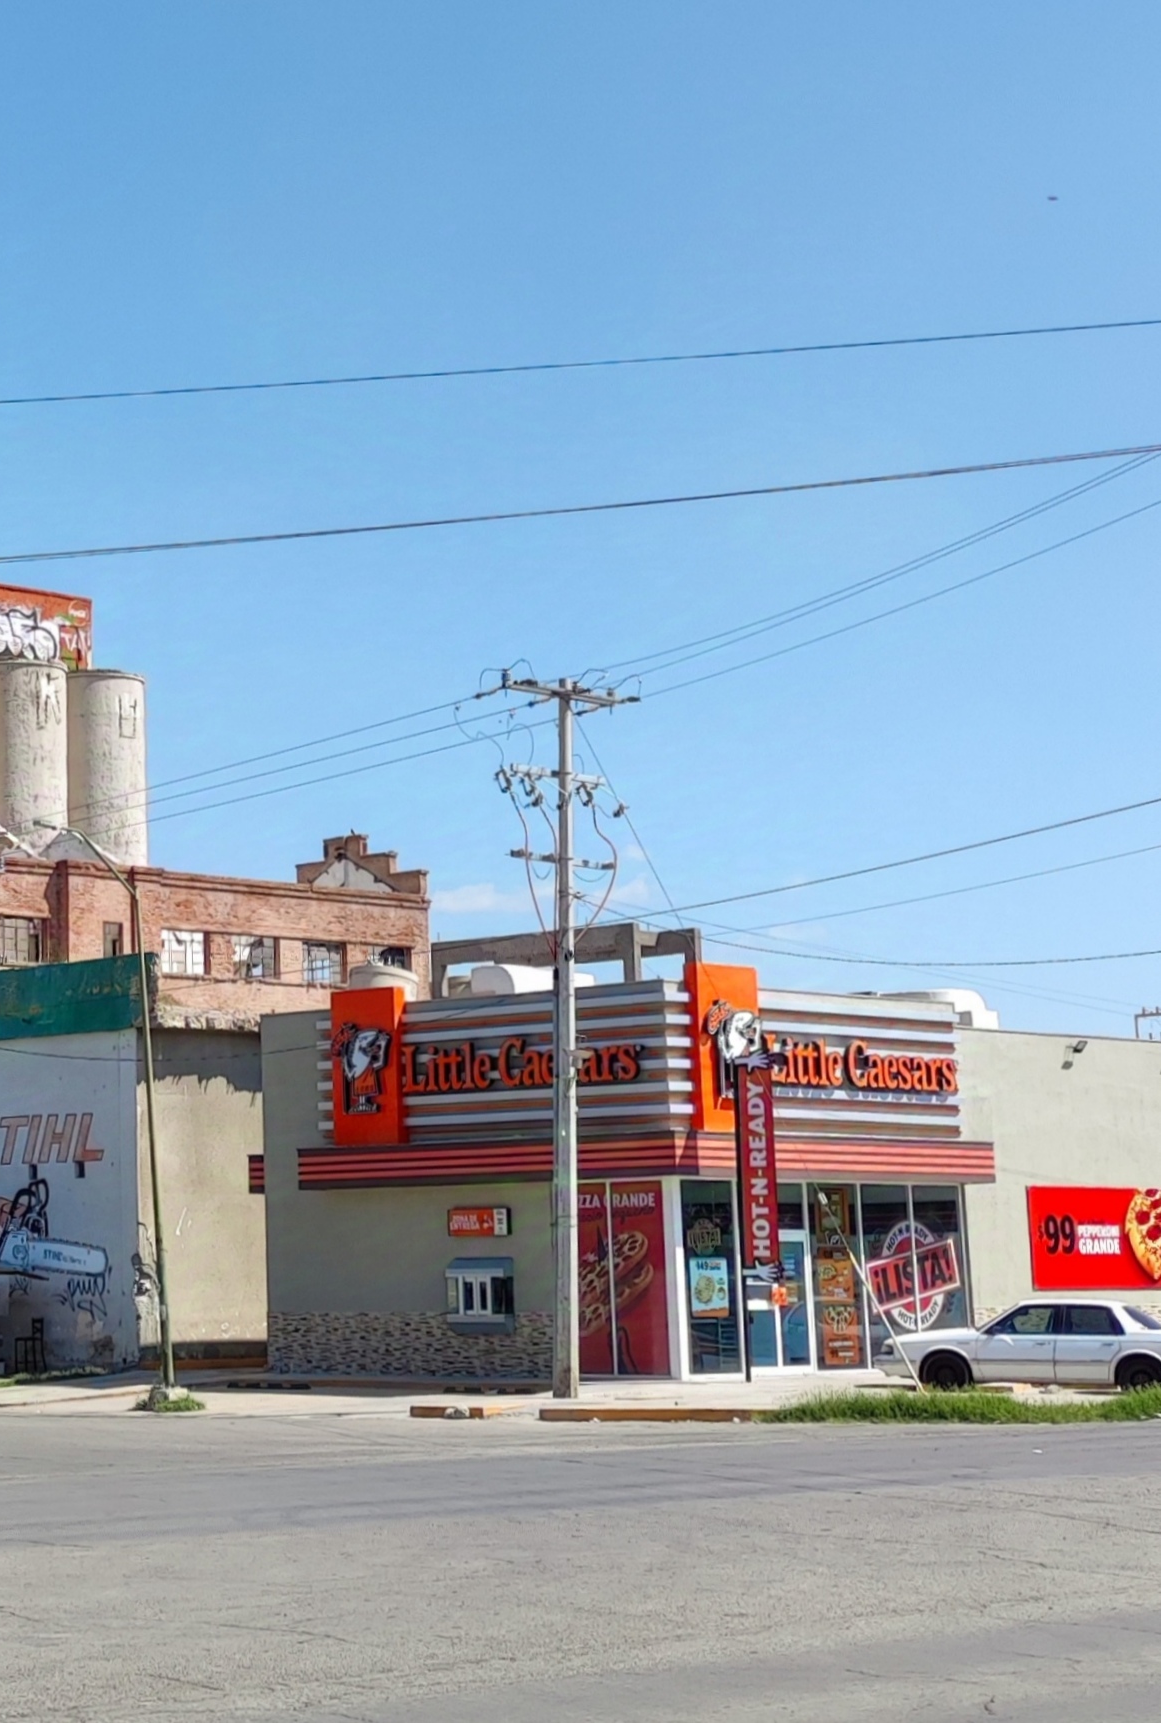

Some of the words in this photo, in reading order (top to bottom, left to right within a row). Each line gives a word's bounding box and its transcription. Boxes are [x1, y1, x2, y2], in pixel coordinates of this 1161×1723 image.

[402, 1041, 491, 1093] Little
[497, 1037, 639, 1087] Caears
[848, 1039, 958, 1093] Caesars
[746, 1078, 771, 1258] HOT-N-READY
[578, 1194, 601, 1208] ZZA
[1078, 1237, 1121, 1255] GRANDE
